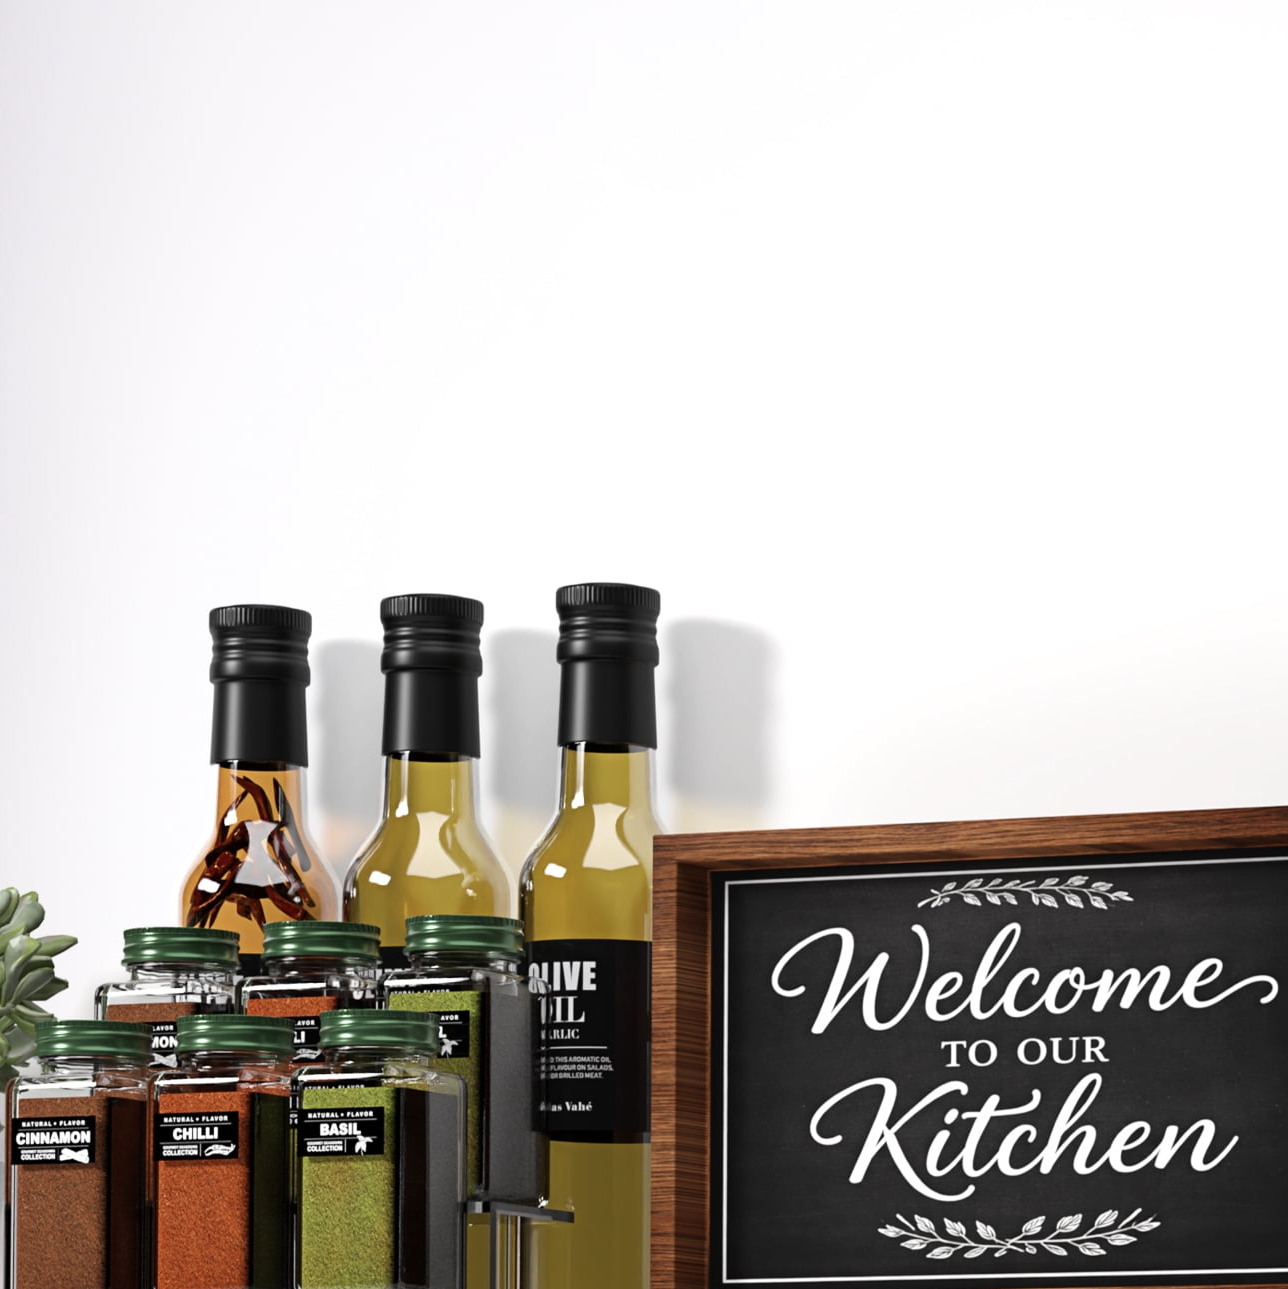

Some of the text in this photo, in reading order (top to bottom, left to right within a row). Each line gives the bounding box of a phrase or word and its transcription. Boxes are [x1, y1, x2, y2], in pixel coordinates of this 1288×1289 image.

[770, 921, 1280, 1035] Welcome
[941, 1035, 1110, 1068] TO OUR
[565, 1101, 593, 1112] Vahé
[21, 1119, 86, 1128] NATURAL FLAVOR
[163, 1115, 195, 1123] NATURAL
[172, 1126, 219, 1141] CHILLI
[319, 1122, 362, 1137] BASIL
[15, 1130, 92, 1146] CINNAMON
[809, 1072, 1240, 1203] Kitchen
